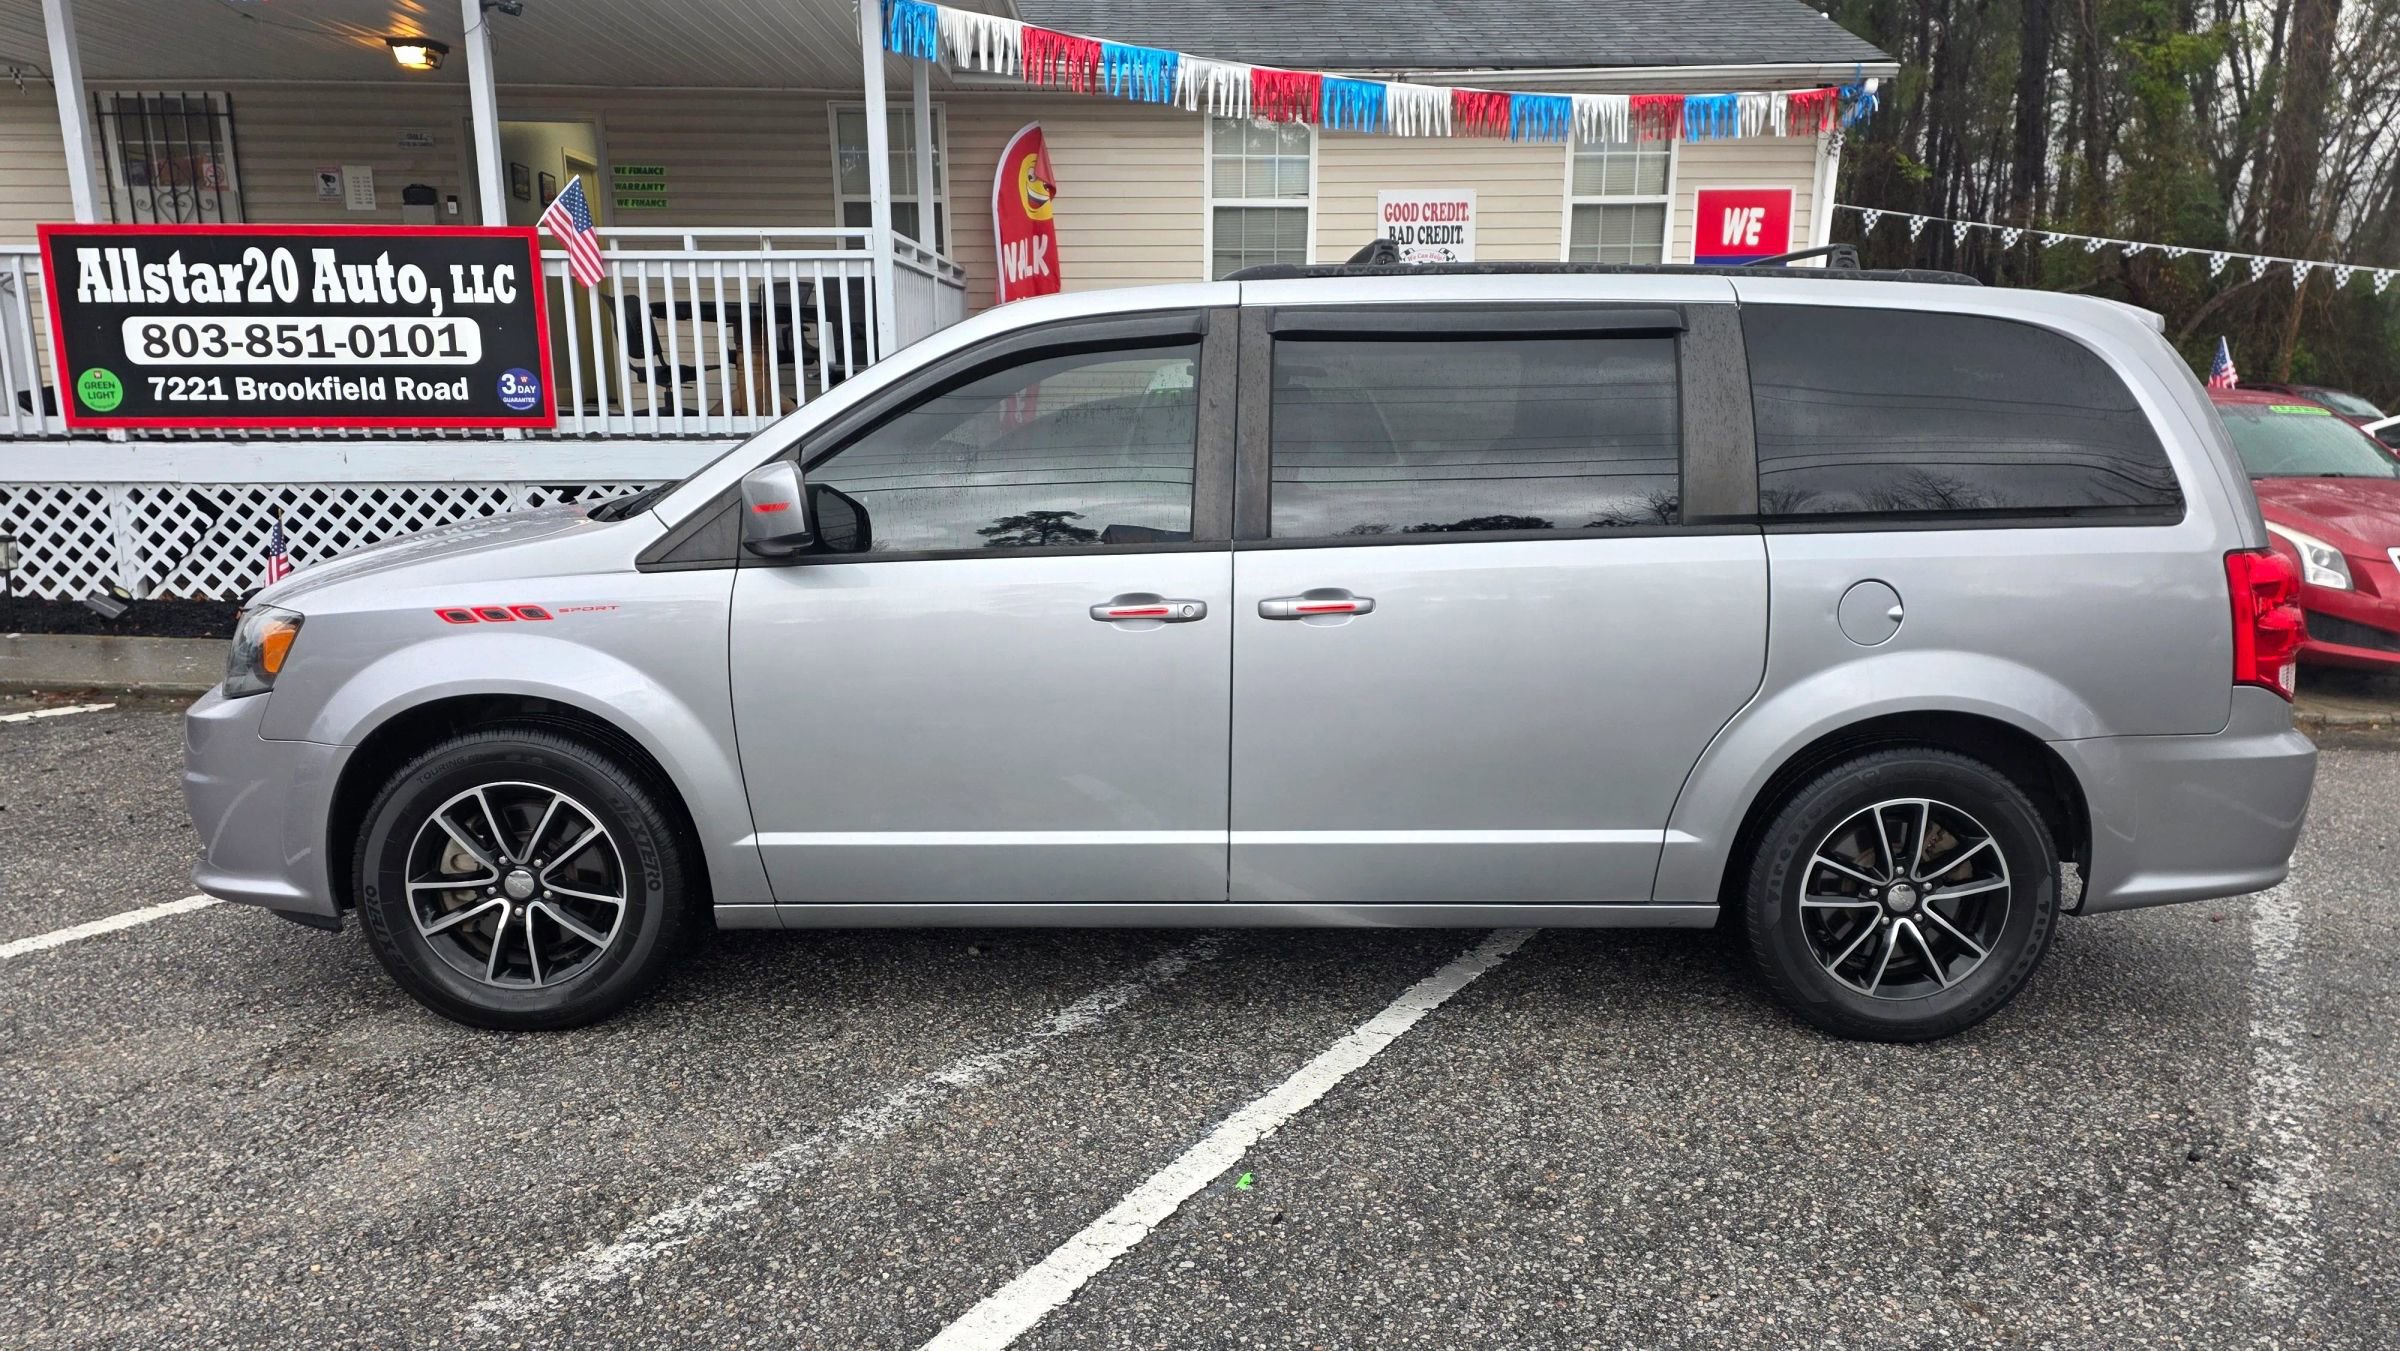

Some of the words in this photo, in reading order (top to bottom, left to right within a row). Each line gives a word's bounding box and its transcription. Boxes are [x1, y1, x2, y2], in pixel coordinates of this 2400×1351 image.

[615, 182, 666, 192] WARRANTY
[1384, 202, 1420, 223] GOOD
[1422, 202, 1470, 222] CREDIT.
[1388, 225, 1415, 245] BAD
[1417, 225, 1464, 245] CREDIT.
[1721, 207, 1766, 247] WE
[76, 246, 299, 304] Allstar20
[311, 248, 444, 317] Auto,
[449, 263, 517, 305] LLC
[141, 322, 468, 359] 803-851-0101
[84, 381, 116, 390] GREEN
[147, 376, 230, 401] 7221
[234, 375, 387, 401] Brookfield
[394, 376, 470, 401] Road
[501, 373, 517, 395] 3
[517, 385, 536, 394] DAY
[87, 390, 115, 400] LIGHT
[558, 605, 621, 613] SPORT
